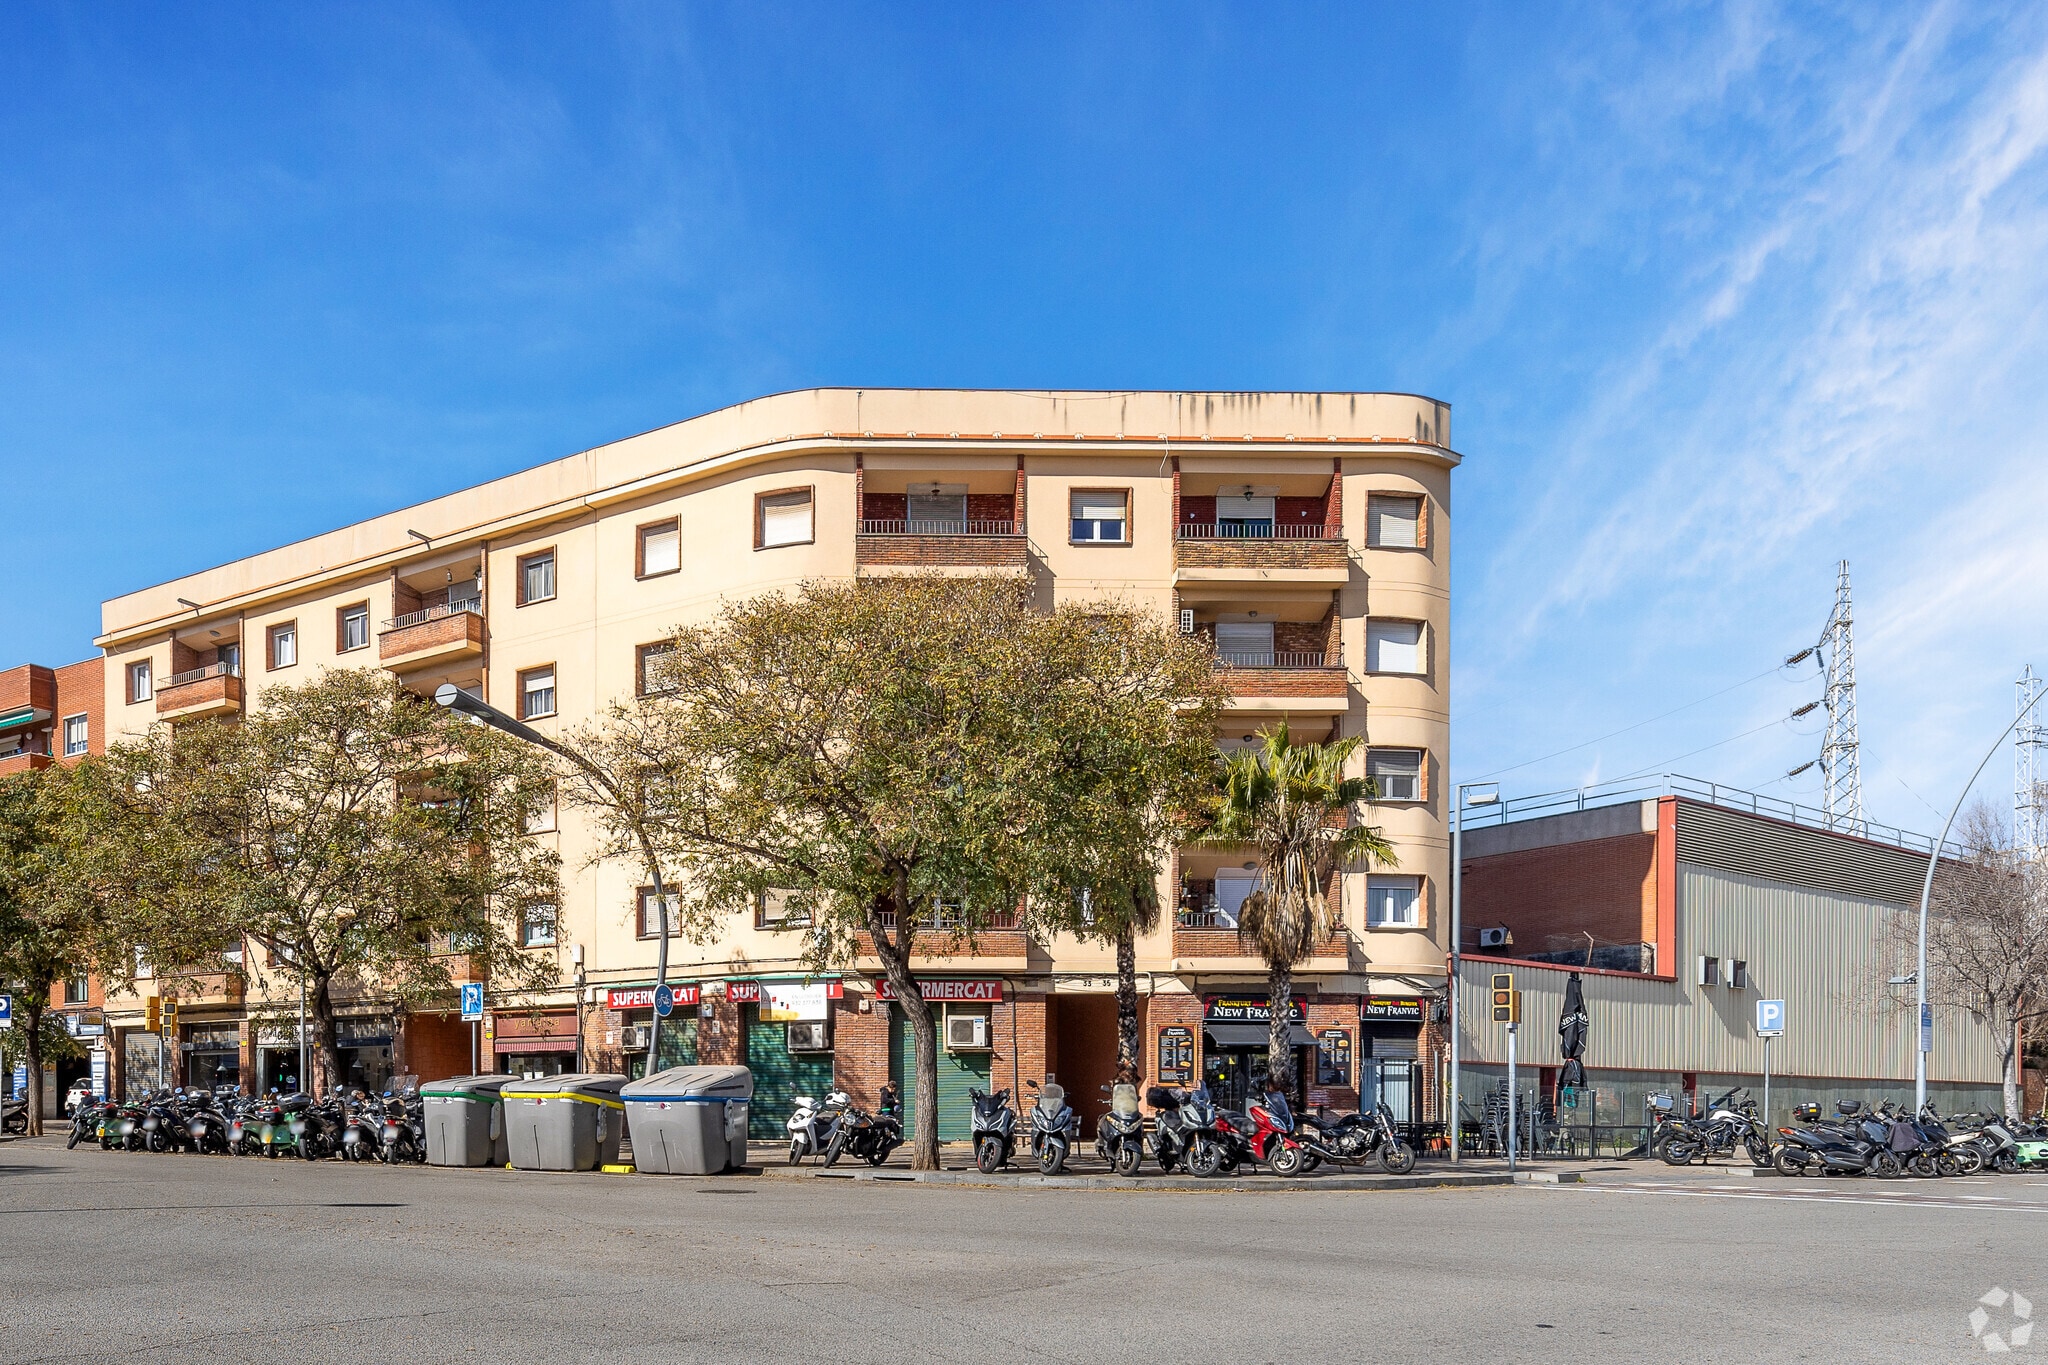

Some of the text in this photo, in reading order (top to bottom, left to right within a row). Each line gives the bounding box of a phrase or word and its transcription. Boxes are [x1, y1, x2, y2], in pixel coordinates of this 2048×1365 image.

[465, 987, 478, 1012] P
[612, 988, 696, 1006] SUPERMCAT
[1213, 1006, 1244, 1017] NEW
[1366, 1005, 1420, 1016] NEW FRANVIC
[1763, 1003, 1779, 1028] P
